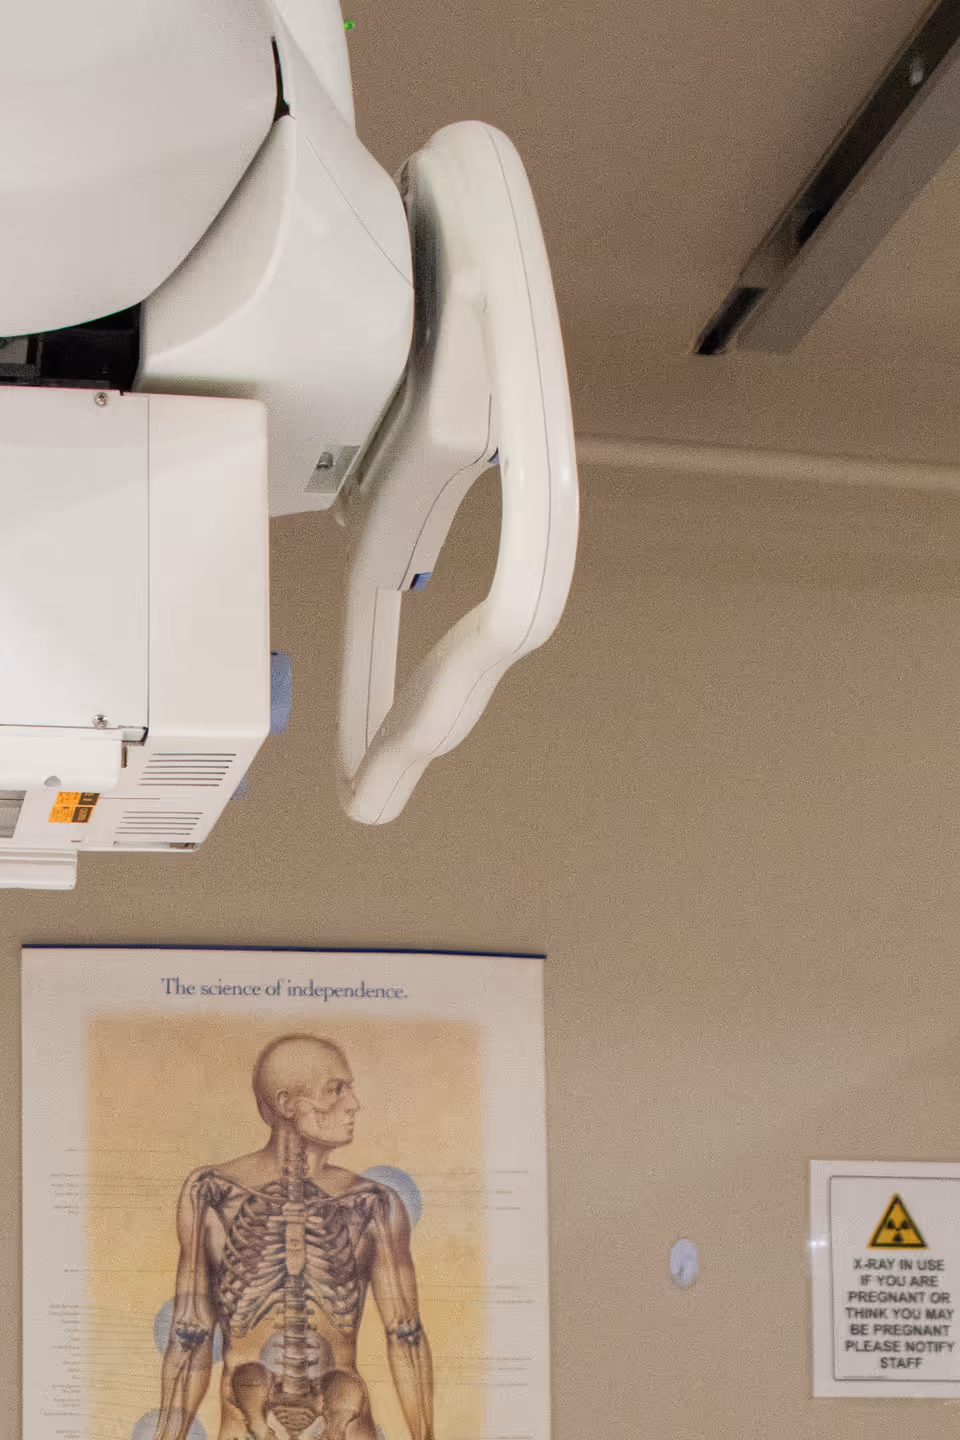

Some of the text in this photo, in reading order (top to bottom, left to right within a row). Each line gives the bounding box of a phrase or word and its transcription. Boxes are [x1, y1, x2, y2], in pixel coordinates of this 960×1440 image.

[161, 977, 409, 1002] The science of independence.
[852, 1257, 945, 1271] X-RAY IN USE
[860, 1275, 939, 1287] IF YOU ARE
[847, 1291, 952, 1304] PREGNANT OR
[845, 1307, 955, 1320] THINK YOU MAY
[850, 1324, 951, 1336] BE PREGNANT
[844, 1340, 956, 1353] PLEASE NOTIFY
[880, 1357, 923, 1369] STAFF
